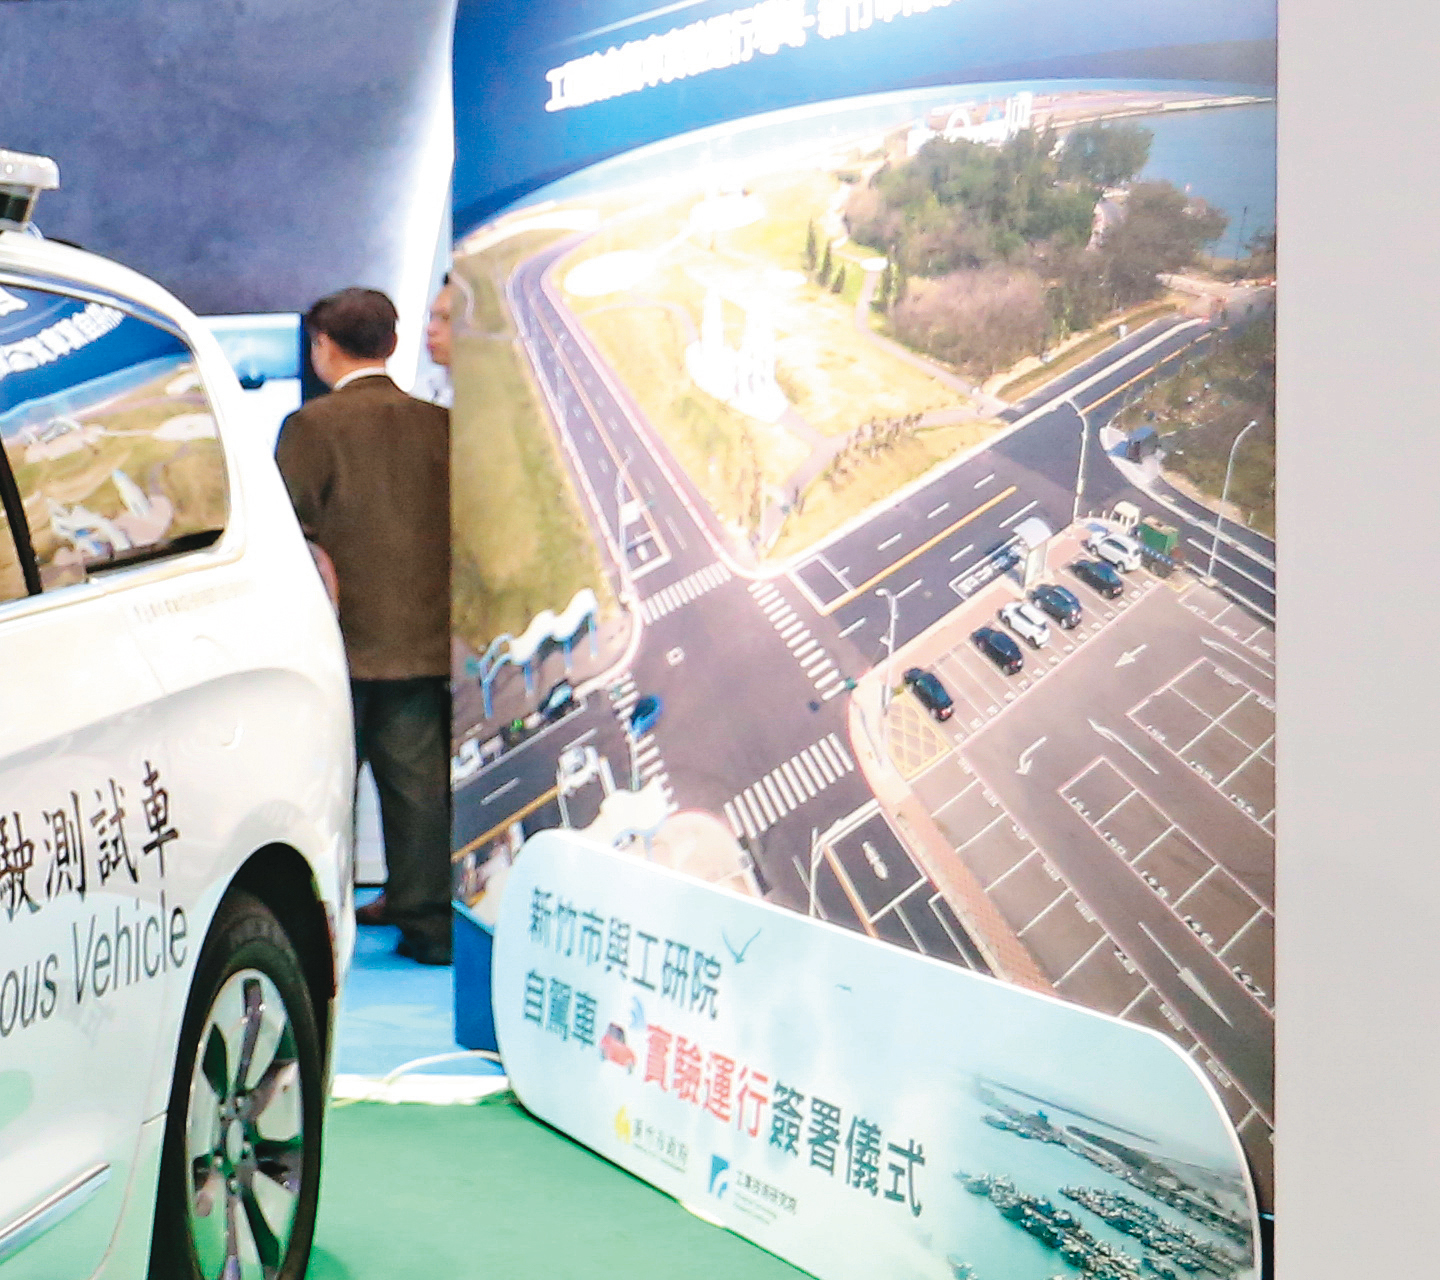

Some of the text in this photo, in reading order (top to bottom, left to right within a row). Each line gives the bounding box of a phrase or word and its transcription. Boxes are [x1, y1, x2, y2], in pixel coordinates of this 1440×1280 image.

[71, 888, 189, 1005] Vehicle
[528, 885, 723, 1020] 新竹市與工研院
[522, 968, 598, 1050] 自駕車
